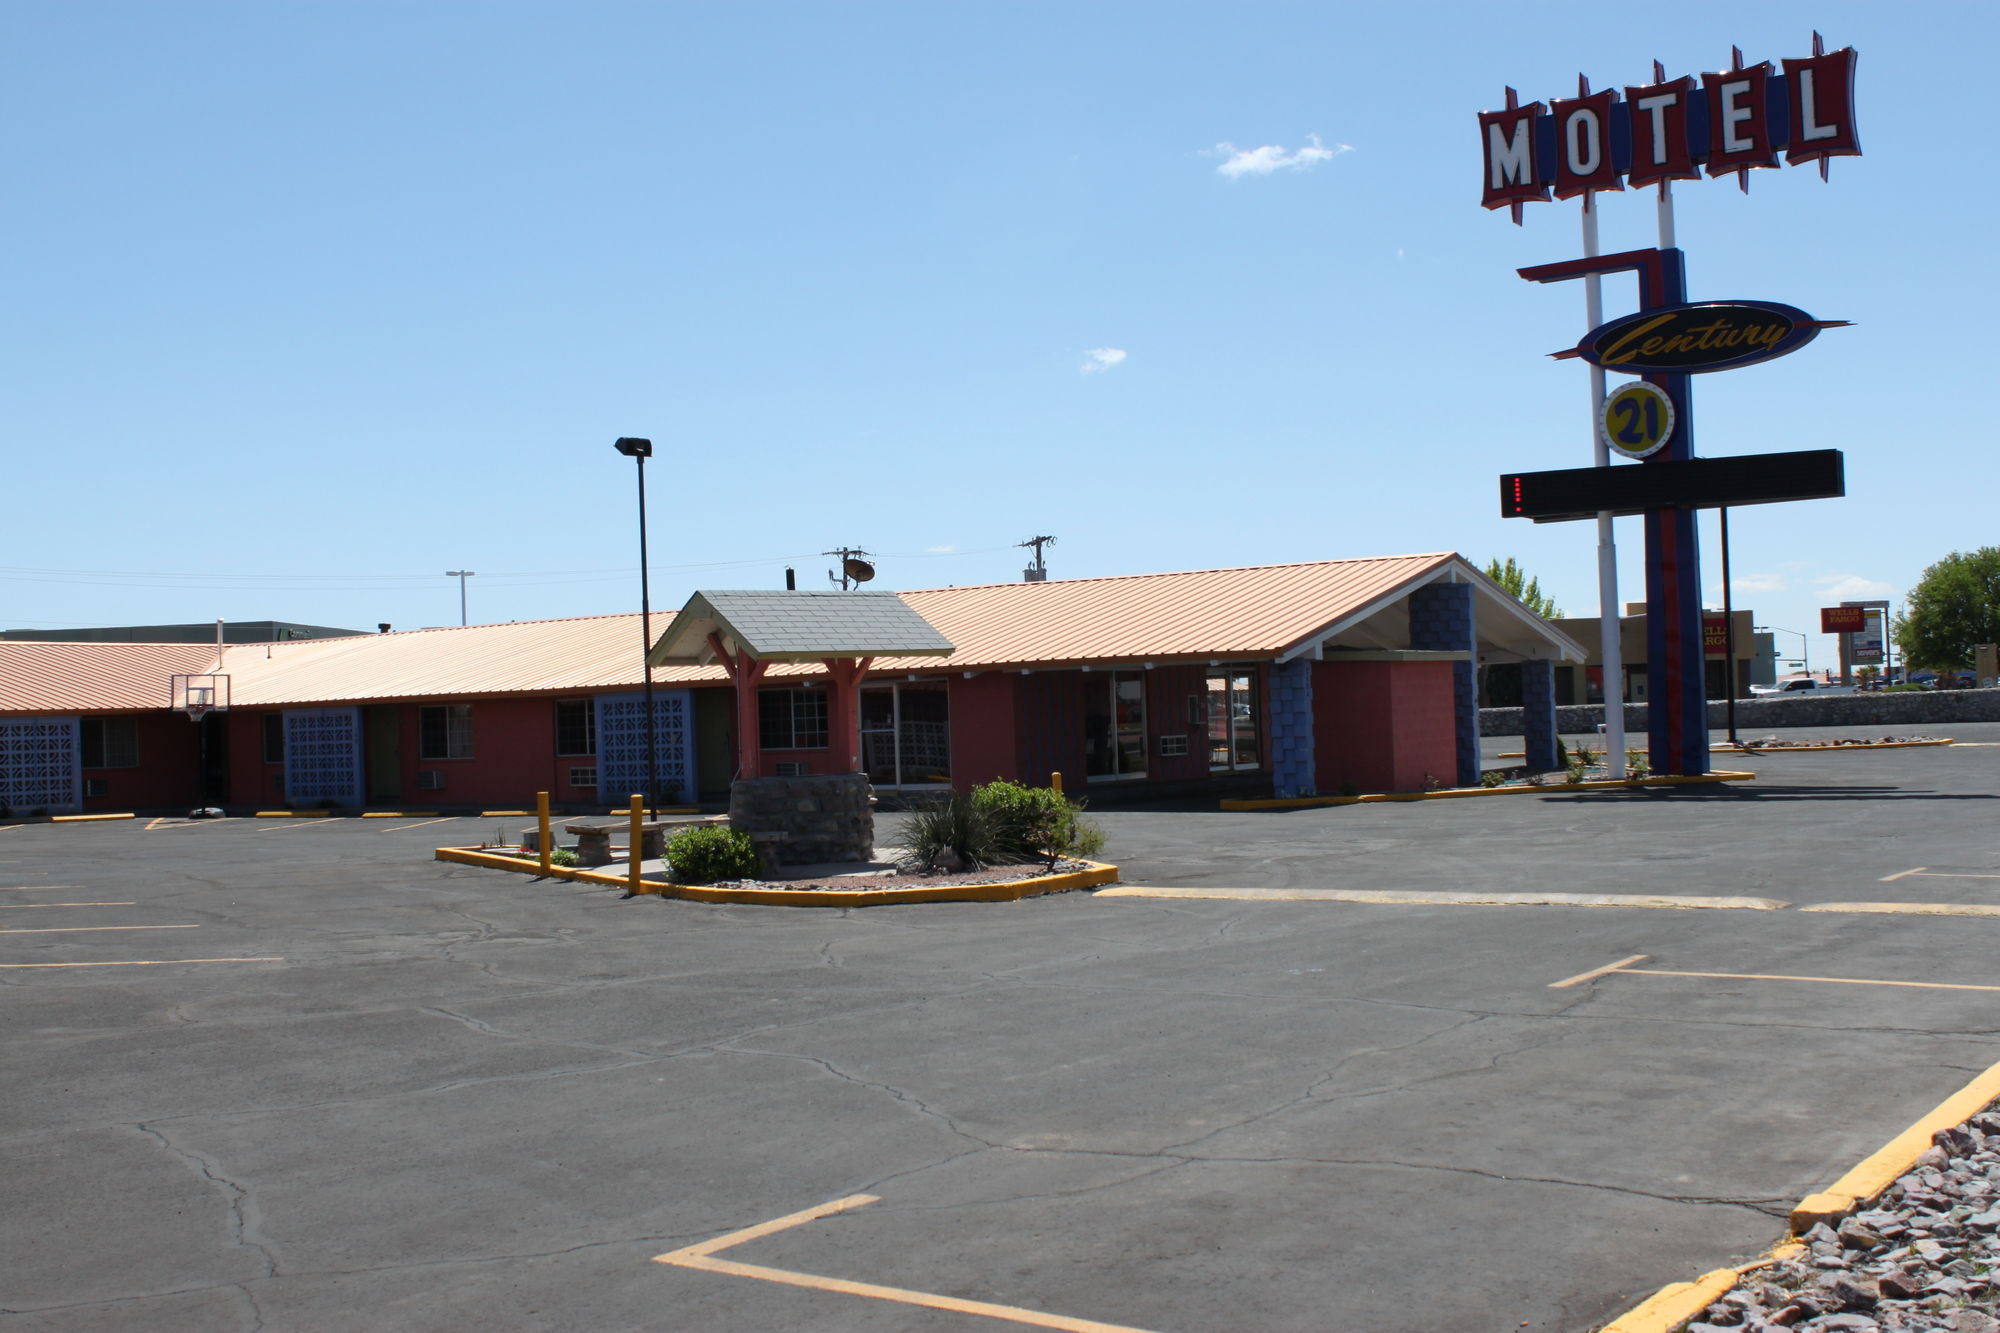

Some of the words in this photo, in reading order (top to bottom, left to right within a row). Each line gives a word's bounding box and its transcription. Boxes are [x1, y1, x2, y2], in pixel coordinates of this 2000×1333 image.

[1488, 68, 1837, 190] MOTEL
[1600, 313, 1787, 365] Century
[1614, 397, 1659, 444] 21
